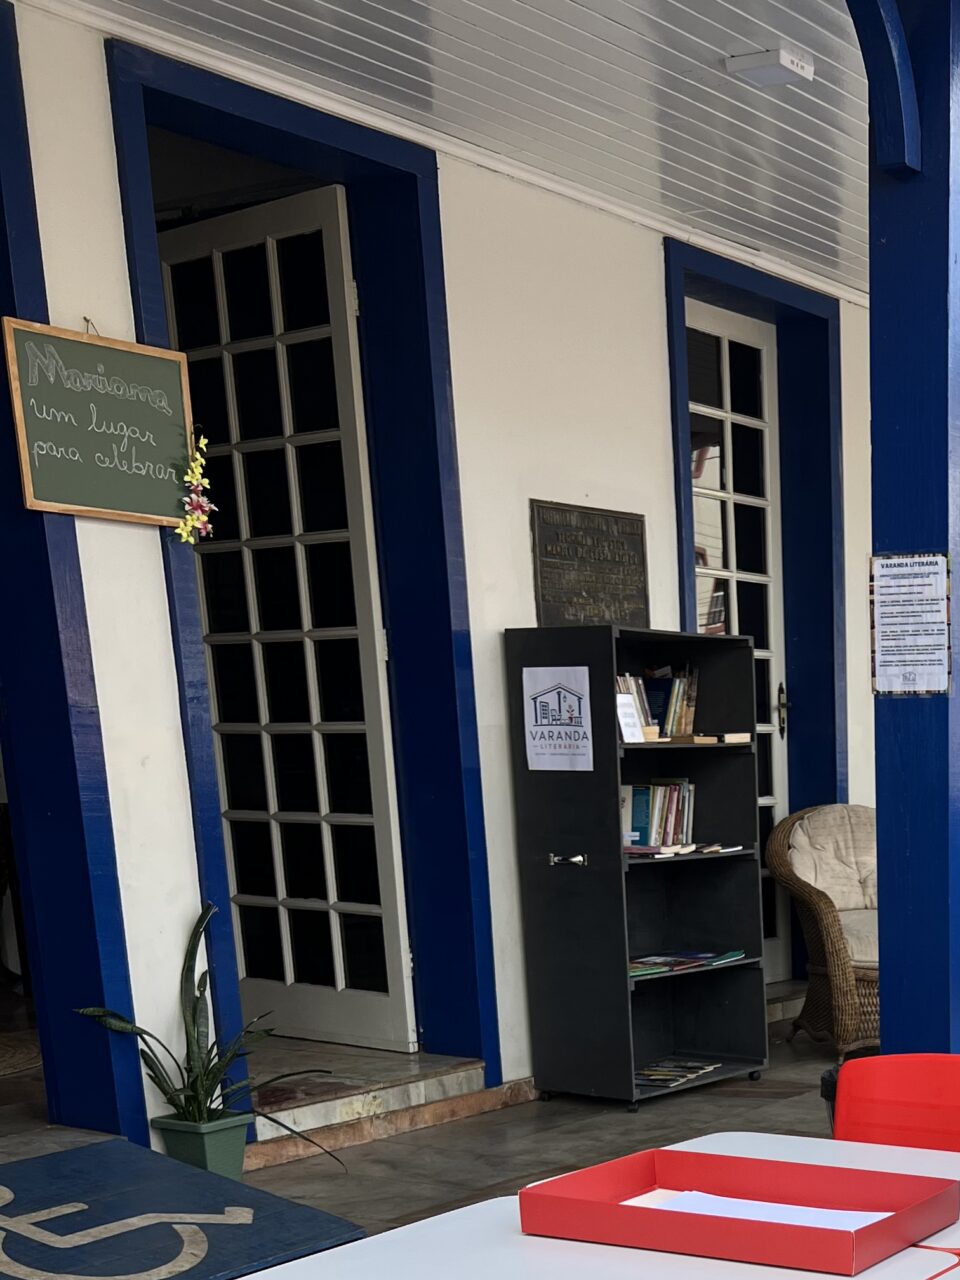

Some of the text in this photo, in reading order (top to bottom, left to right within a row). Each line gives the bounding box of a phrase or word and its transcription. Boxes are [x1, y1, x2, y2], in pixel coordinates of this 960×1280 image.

[24, 340, 173, 417] Mariana
[87, 402, 157, 453] lugar
[32, 440, 180, 485] para celebrar
[880, 561, 909, 569] VARANDA
[529, 730, 590, 742] VARANDA
